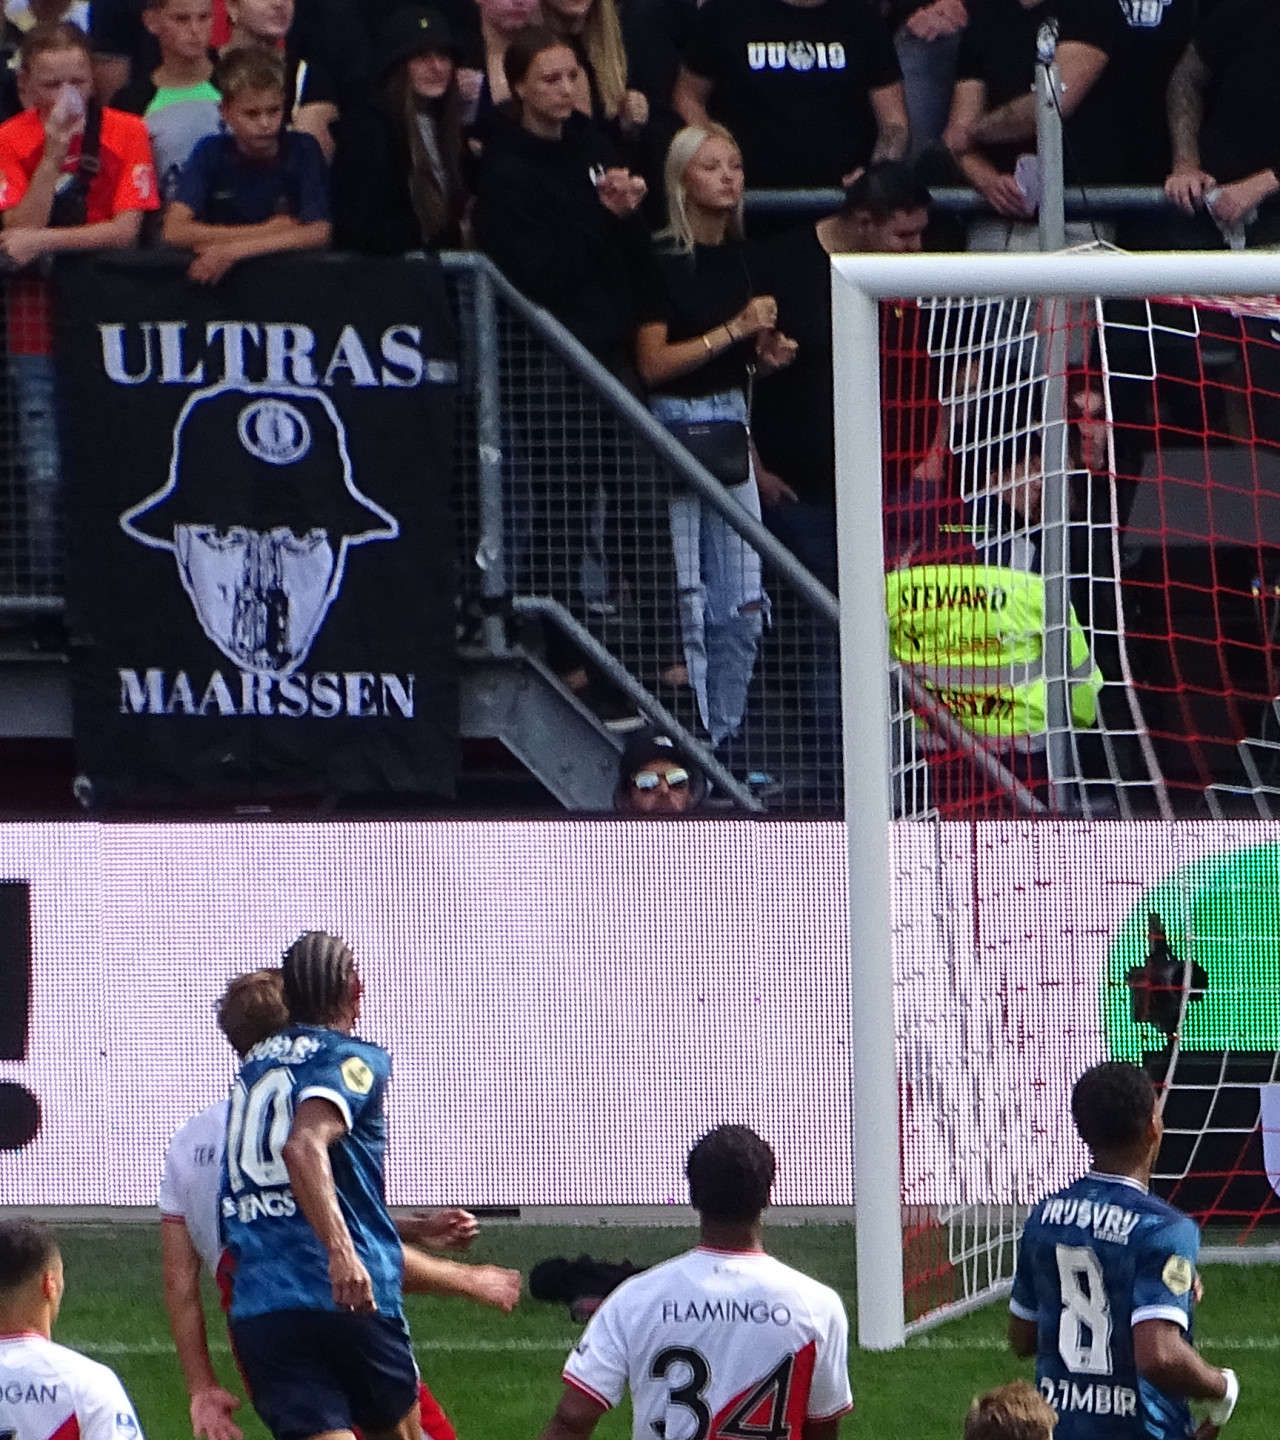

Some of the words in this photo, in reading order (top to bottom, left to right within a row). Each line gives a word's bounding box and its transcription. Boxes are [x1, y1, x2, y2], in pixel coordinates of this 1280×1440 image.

[98, 321, 423, 388] ULTRAS
[901, 584, 1007, 611] STEWARD
[118, 667, 415, 718] MAARSSEN
[227, 1066, 297, 1194] 10
[661, 1300, 791, 1327] FLAMINGO
[1055, 1242, 1114, 1376] 8
